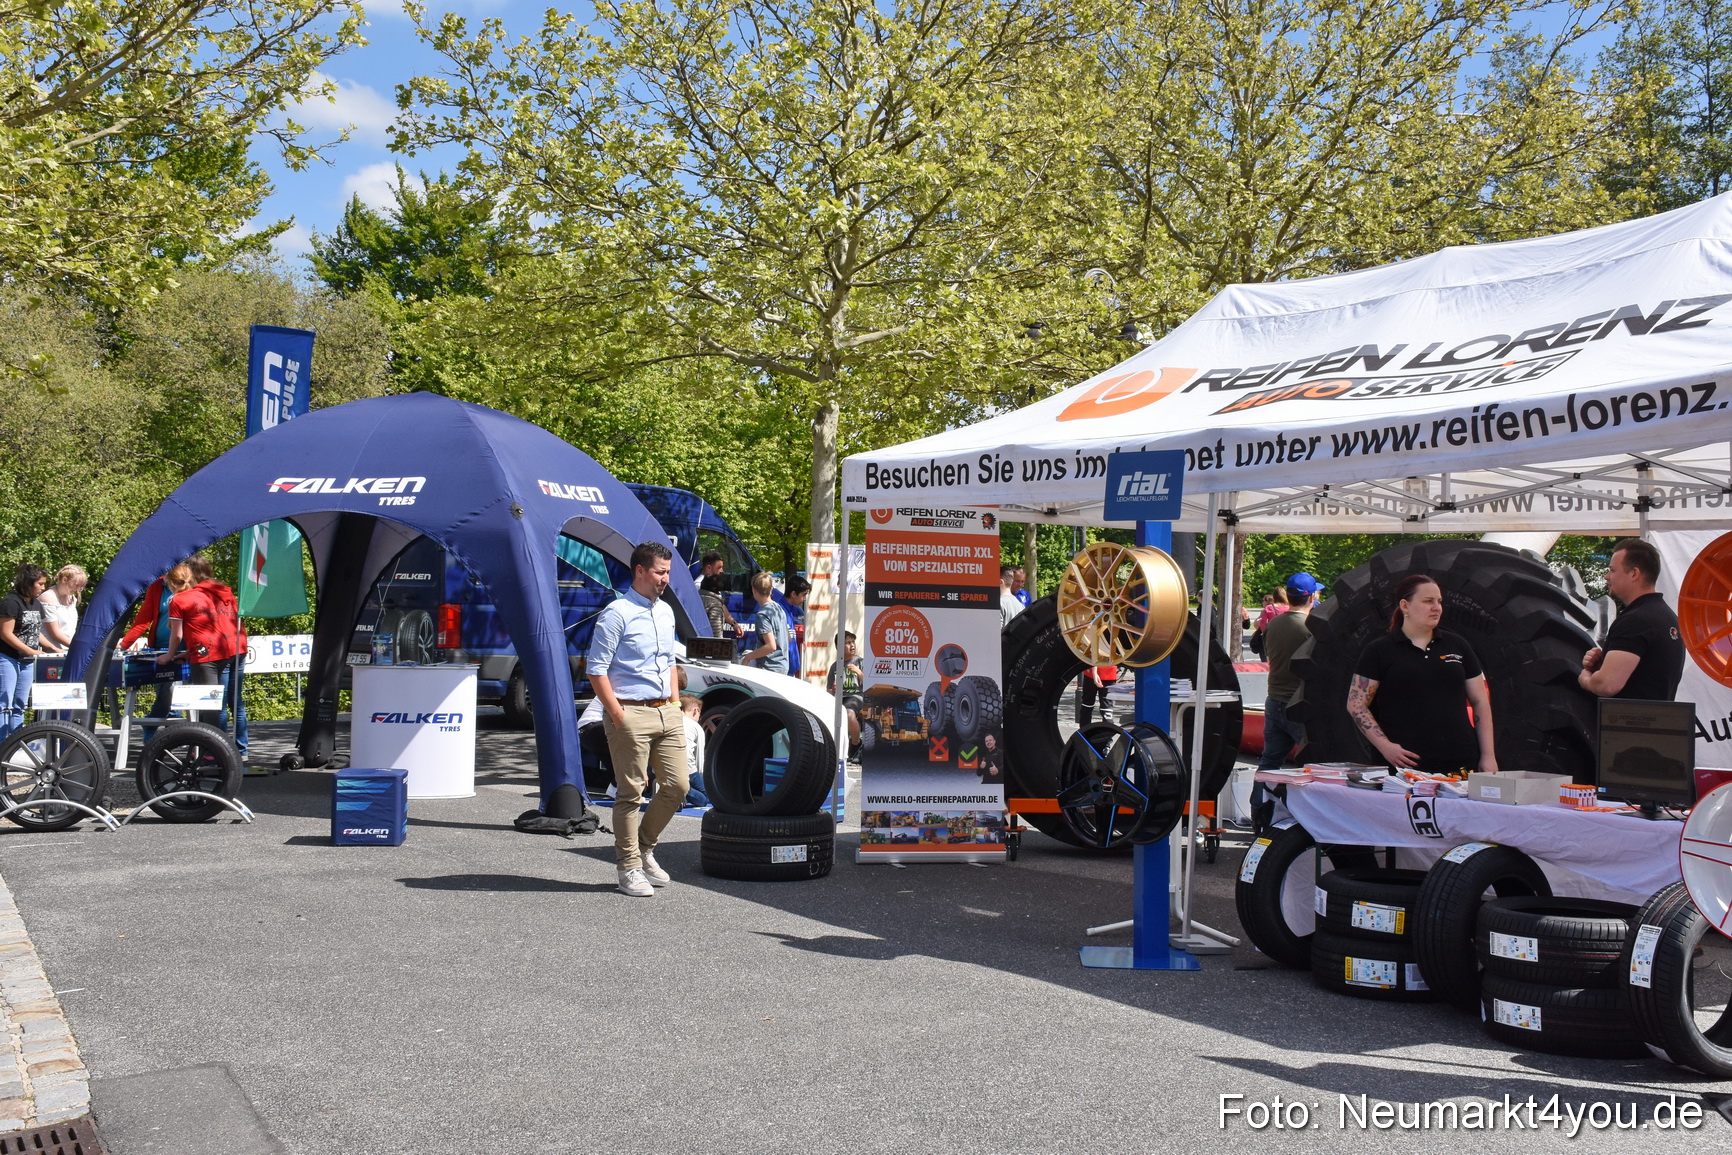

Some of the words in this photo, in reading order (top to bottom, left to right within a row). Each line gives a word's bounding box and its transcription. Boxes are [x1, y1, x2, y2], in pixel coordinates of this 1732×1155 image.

[1182, 343, 1408, 393] REIFEN
[1400, 293, 1732, 372] LORENZ
[281, 359, 300, 421] PULSE
[1220, 379, 1355, 412] AUTO
[1350, 355, 1566, 398] SERVICE
[865, 459, 970, 490] Besuchen
[978, 453, 1014, 484] Sie
[1022, 457, 1067, 482] uns
[1075, 450, 1106, 479] im
[1234, 432, 1321, 468] unter
[267, 476, 427, 494] FALKEN
[537, 479, 605, 503] FALKEN
[378, 496, 416, 506] TYRES
[896, 507, 933, 517] REIFEN
[935, 509, 977, 519] LORENZ
[911, 518, 933, 526] AUTO
[933, 519, 964, 528] SERVICE
[872, 542, 971, 558] REIFENREPARATUR
[973, 546, 993, 558] XXL
[883, 560, 907, 572] VOM
[910, 561, 983, 575] SPEZIALISTEN
[878, 591, 893, 599] WIR
[895, 591, 940, 600] REPARIEREN
[960, 593, 988, 602] SPAREN
[885, 628, 919, 644] 80%
[885, 645, 919, 655] SPAREN
[896, 659, 918, 670] MTR
[368, 712, 463, 724] FALKEN
[1695, 710, 1732, 743] Au
[867, 795, 998, 804] WWW.REILO-REIFENREPARATUR.DE
